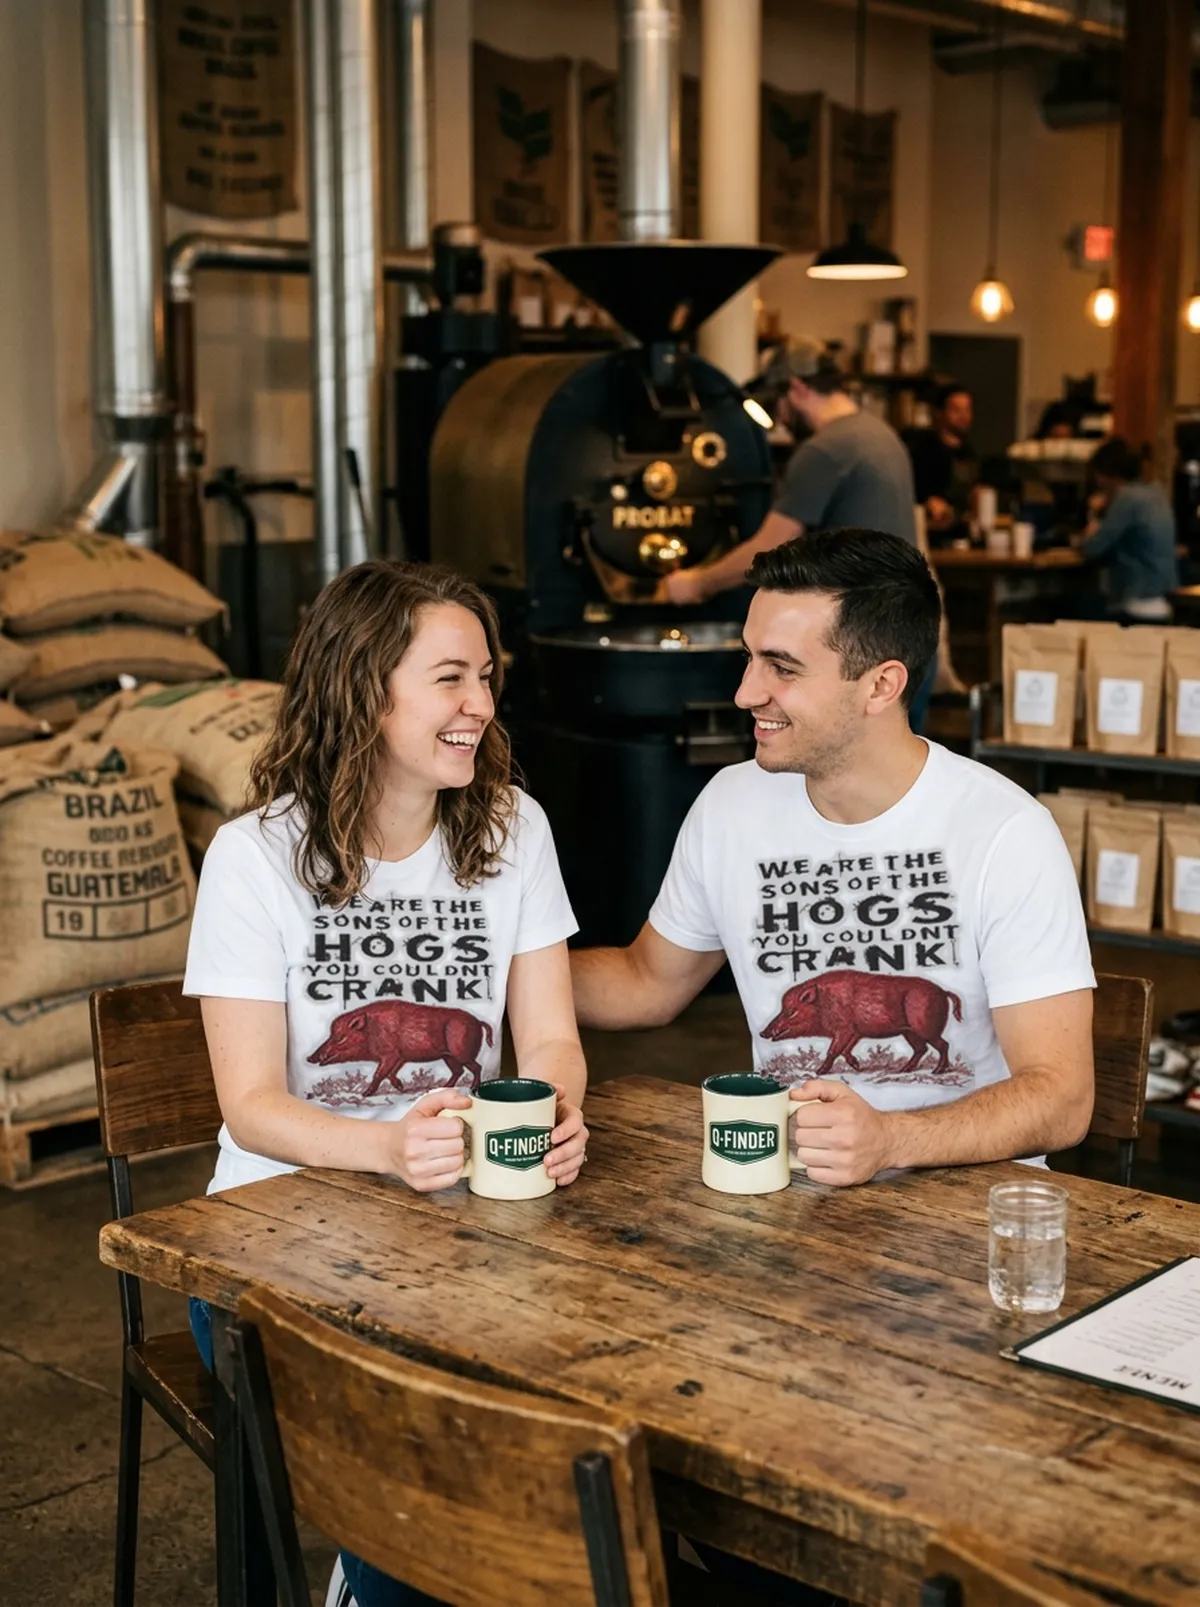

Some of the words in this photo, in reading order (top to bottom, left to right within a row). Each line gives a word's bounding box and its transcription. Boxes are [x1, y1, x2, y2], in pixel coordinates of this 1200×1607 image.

[64, 785, 164, 819] BRAZIL
[42, 847, 112, 869] COFFEE
[758, 858, 809, 880] WE
[815, 856, 874, 877] ARE
[884, 851, 943, 871] THE
[47, 854, 182, 898] GUATEMALA
[761, 879, 840, 899] SONS
[847, 875, 881, 891] OF
[887, 871, 948, 890] THE
[369, 897, 423, 913] ARE
[432, 899, 483, 914] THE
[762, 891, 954, 934] HOGS
[56, 909, 84, 931] 19
[312, 914, 391, 930] SONS
[399, 916, 429, 930] OF
[434, 916, 487, 931] THE
[314, 933, 490, 962] HOGS
[754, 933, 809, 949] YOU
[822, 925, 960, 944] COULDNT
[305, 963, 360, 977] YOU
[373, 964, 494, 977] COULDNT
[756, 942, 946, 974] CRANK
[306, 977, 483, 1003] CRANK
